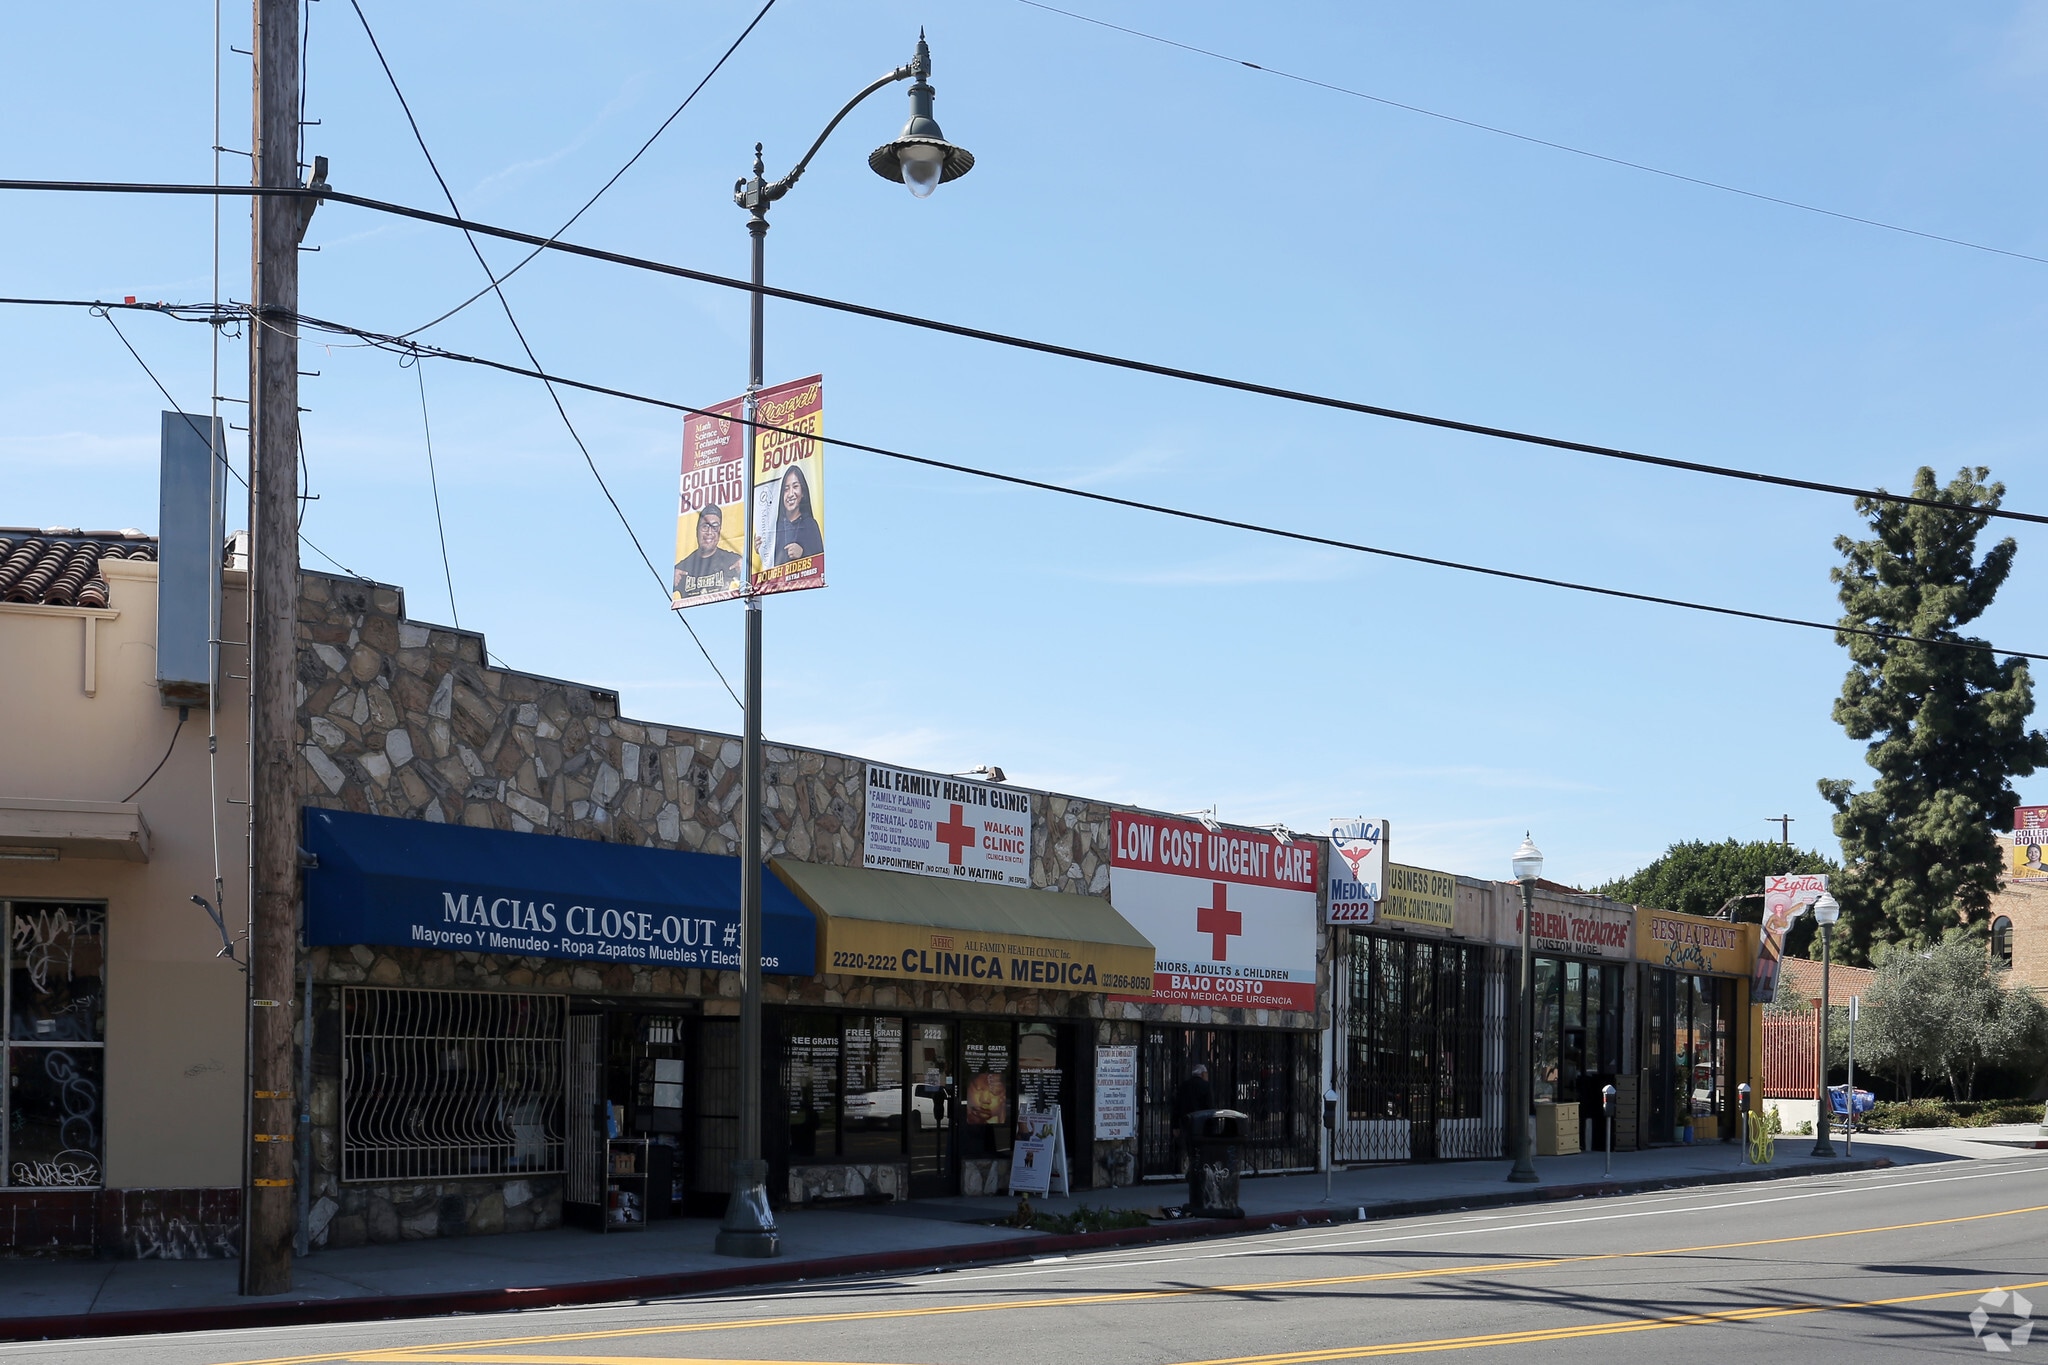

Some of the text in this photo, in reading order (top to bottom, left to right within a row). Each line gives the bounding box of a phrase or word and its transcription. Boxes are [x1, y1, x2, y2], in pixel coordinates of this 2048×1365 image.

[759, 384, 819, 425] Roosevelt
[787, 411, 795, 421] IS
[695, 430, 718, 442] Science
[695, 435, 731, 450] Technology
[762, 416, 816, 450] COLLEGE
[762, 437, 816, 473] BOUND
[682, 461, 743, 492] COLLEGE
[680, 480, 743, 513] BOUND
[784, 558, 812, 576] RIDERS
[869, 768, 1027, 813] ALL FAMILY HEALTH CLINIC
[872, 791, 930, 810] FAMILY PLANNING
[984, 821, 1023, 837] WALK-IN
[1331, 823, 1380, 847] CLINICA
[889, 834, 930, 850] ULTRASOUND
[983, 836, 1025, 854] CLINIC
[1117, 821, 1312, 884] LOW COST URGENT CARE
[865, 854, 875, 864] NO
[876, 856, 925, 871] APPOINTMENT
[953, 865, 966, 876] NO
[968, 867, 1004, 881] WAITING
[1389, 869, 1453, 898] USINESS OPEN
[1766, 876, 1825, 899] Lupitas
[442, 892, 557, 933] MACIAS
[566, 905, 717, 947] CLOSE-OUT
[1332, 903, 1369, 920] 2222
[1516, 910, 1568, 941] MEBLERIA
[1651, 918, 1736, 950] RESTAURANT
[411, 924, 473, 946] Mayoreo
[476, 931, 486, 946] Y
[490, 933, 550, 951] Menudeo
[561, 938, 594, 957] Ropa
[597, 941, 646, 959] Zapatos
[649, 945, 697, 962] Muebles
[700, 950, 708, 963] Y
[932, 938, 1072, 959] AFHC ALL FAMILY HEALTH CLINIC Inc.
[1536, 939, 1598, 955] CUSTOM MADE
[833, 951, 897, 971] 2220-2222
[901, 948, 1004, 980] CLINICA
[1010, 958, 1098, 986] MEDICA
[1194, 964, 1232, 976] ADULTS
[1234, 969, 1241, 977] &
[1243, 968, 1289, 980] CHILDREN
[1171, 975, 1263, 994] BAJO COSTO
[1190, 992, 1228, 1002] MEDICA
[1231, 994, 1243, 1003] DE
[1245, 995, 1293, 1005] URGENCIA
[812, 1037, 839, 1045] GRATIS
[845, 1029, 902, 1037] FREE GRATIS
[923, 1029, 942, 1040] 2222
